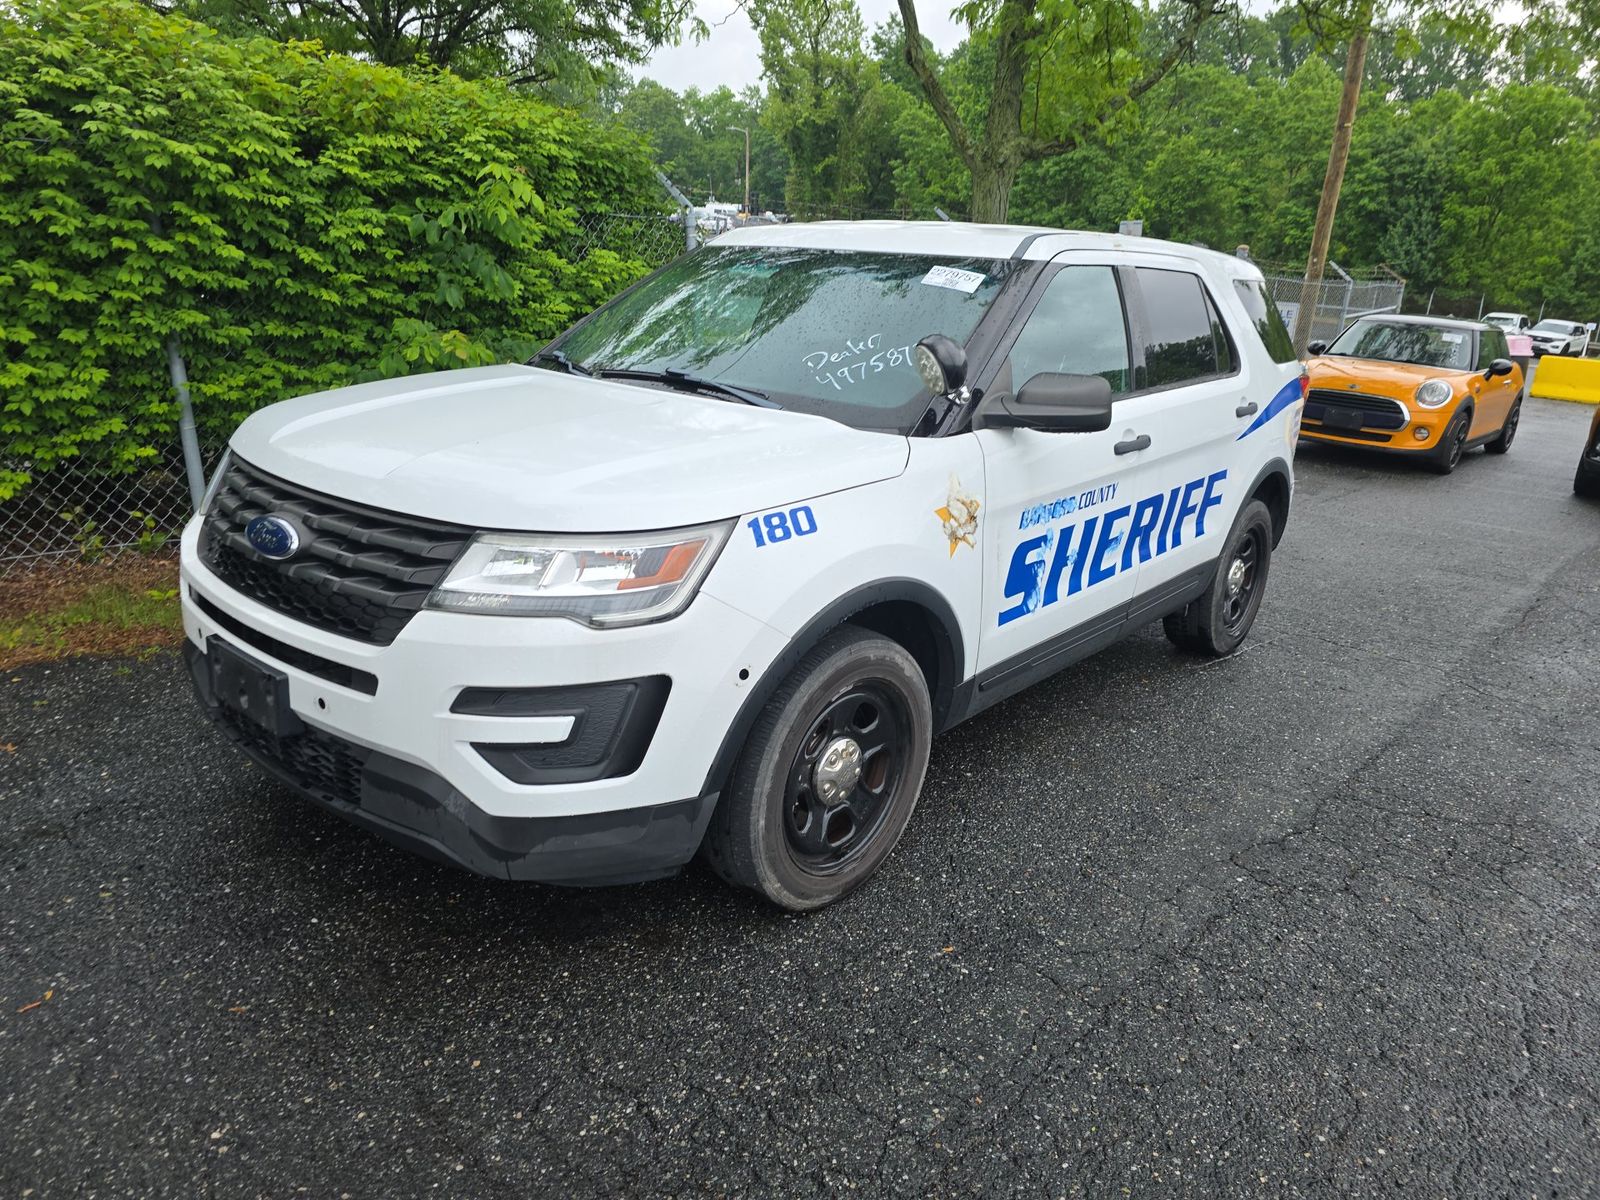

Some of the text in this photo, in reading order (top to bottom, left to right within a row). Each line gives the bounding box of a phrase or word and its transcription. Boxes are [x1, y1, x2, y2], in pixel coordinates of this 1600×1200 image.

[815, 343, 917, 391] 497587
[1078, 481, 1119, 510] COUNTY
[747, 505, 818, 548] 180
[998, 469, 1228, 627] SHERIFF
